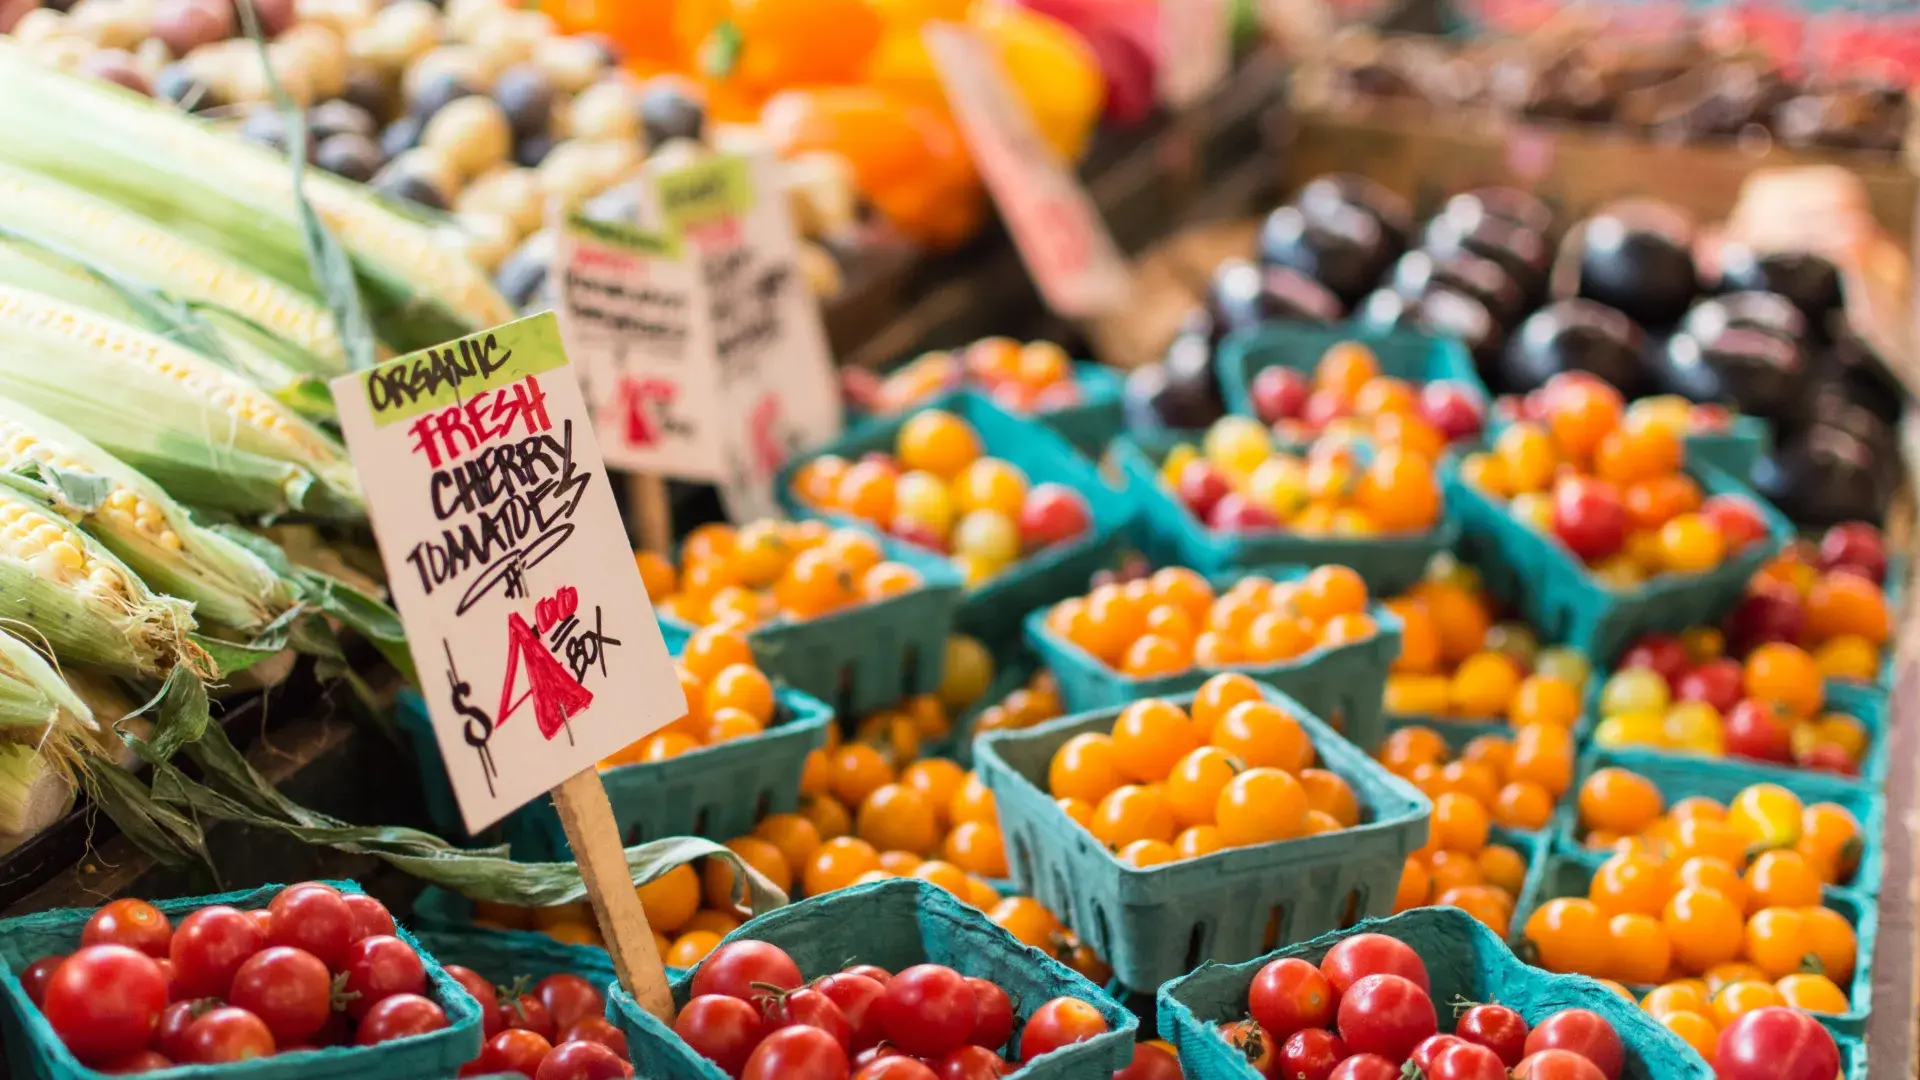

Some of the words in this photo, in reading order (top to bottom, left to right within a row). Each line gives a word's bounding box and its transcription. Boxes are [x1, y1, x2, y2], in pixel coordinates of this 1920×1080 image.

[369, 334, 512, 412] ORGANIC
[408, 375, 552, 469] FRESH
[431, 419, 573, 520] CHERRY
[407, 463, 591, 595] TOMATOES
[565, 606, 621, 684] BOX
